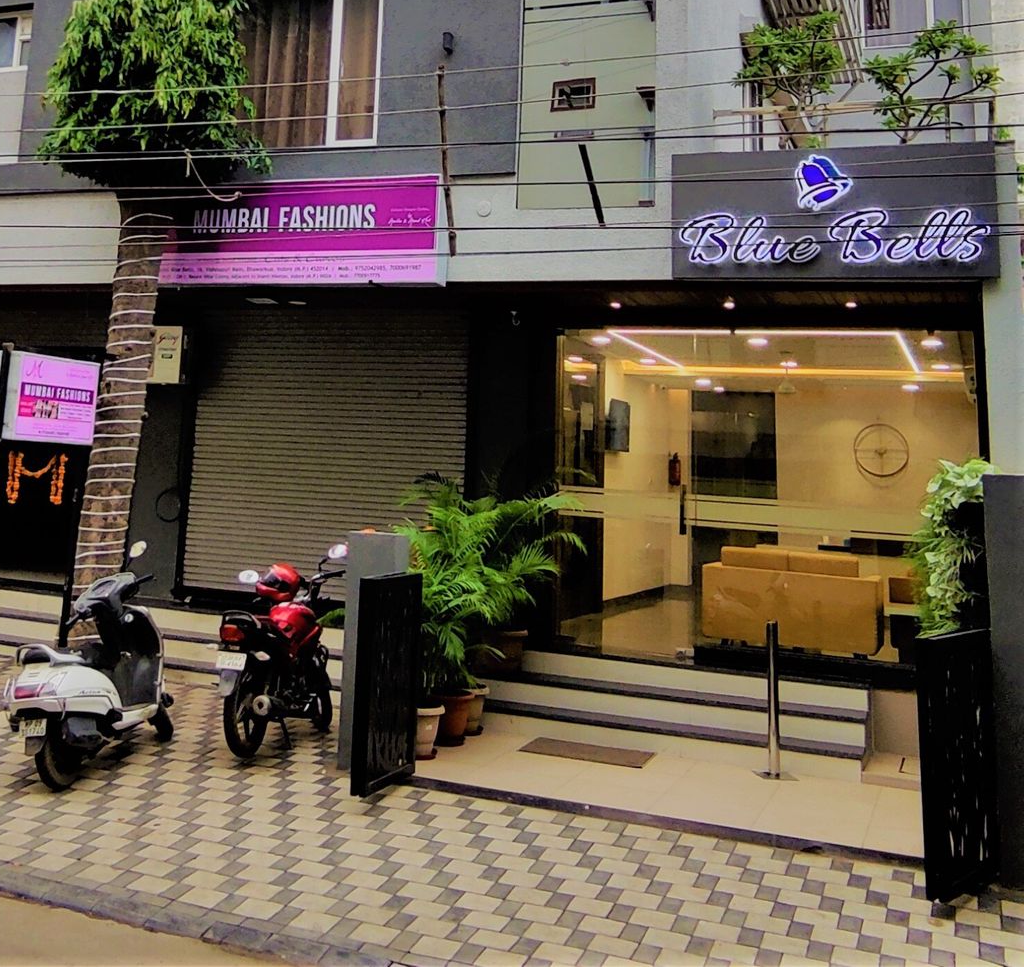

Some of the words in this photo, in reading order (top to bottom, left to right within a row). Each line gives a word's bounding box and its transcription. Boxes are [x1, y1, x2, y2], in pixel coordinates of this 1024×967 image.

[193, 207, 269, 234] MUMBAI
[278, 203, 376, 233] FASHIONS
[680, 212, 821, 265] Blue
[828, 207, 991, 264] Bells
[24, 384, 55, 399] MUMBAI
[56, 387, 91, 403] FASHIONS
